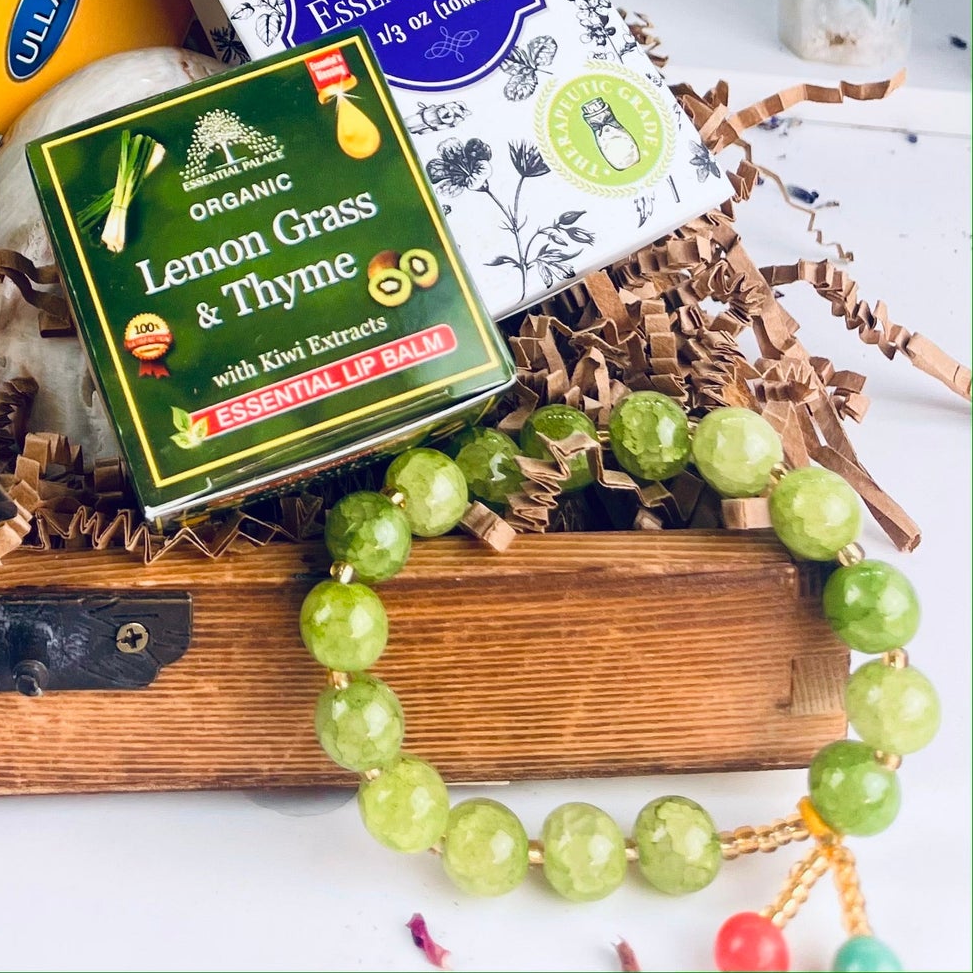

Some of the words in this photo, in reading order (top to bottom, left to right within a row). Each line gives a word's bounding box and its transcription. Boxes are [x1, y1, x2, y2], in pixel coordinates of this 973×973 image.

[376, 22, 408, 46] 1/3
[554, 80, 615, 178] THERAPEUTIC
[618, 85, 659, 147] GRADE
[182, 164, 243, 192] ESSENTIAL
[241, 150, 285, 172] PALACE
[189, 172, 293, 221] ORGANIC
[135, 230, 270, 296] Lemon
[273, 191, 377, 245] Grass
[196, 302, 223, 329] &
[221, 252, 358, 317] Thyme
[212, 358, 258, 388] with
[258, 340, 307, 372] Kiwi
[306, 315, 388, 356] Extracts
[215, 371, 342, 427] ESSENTIAL
[342, 356, 376, 382] LIP
[380, 332, 444, 369] BALM
